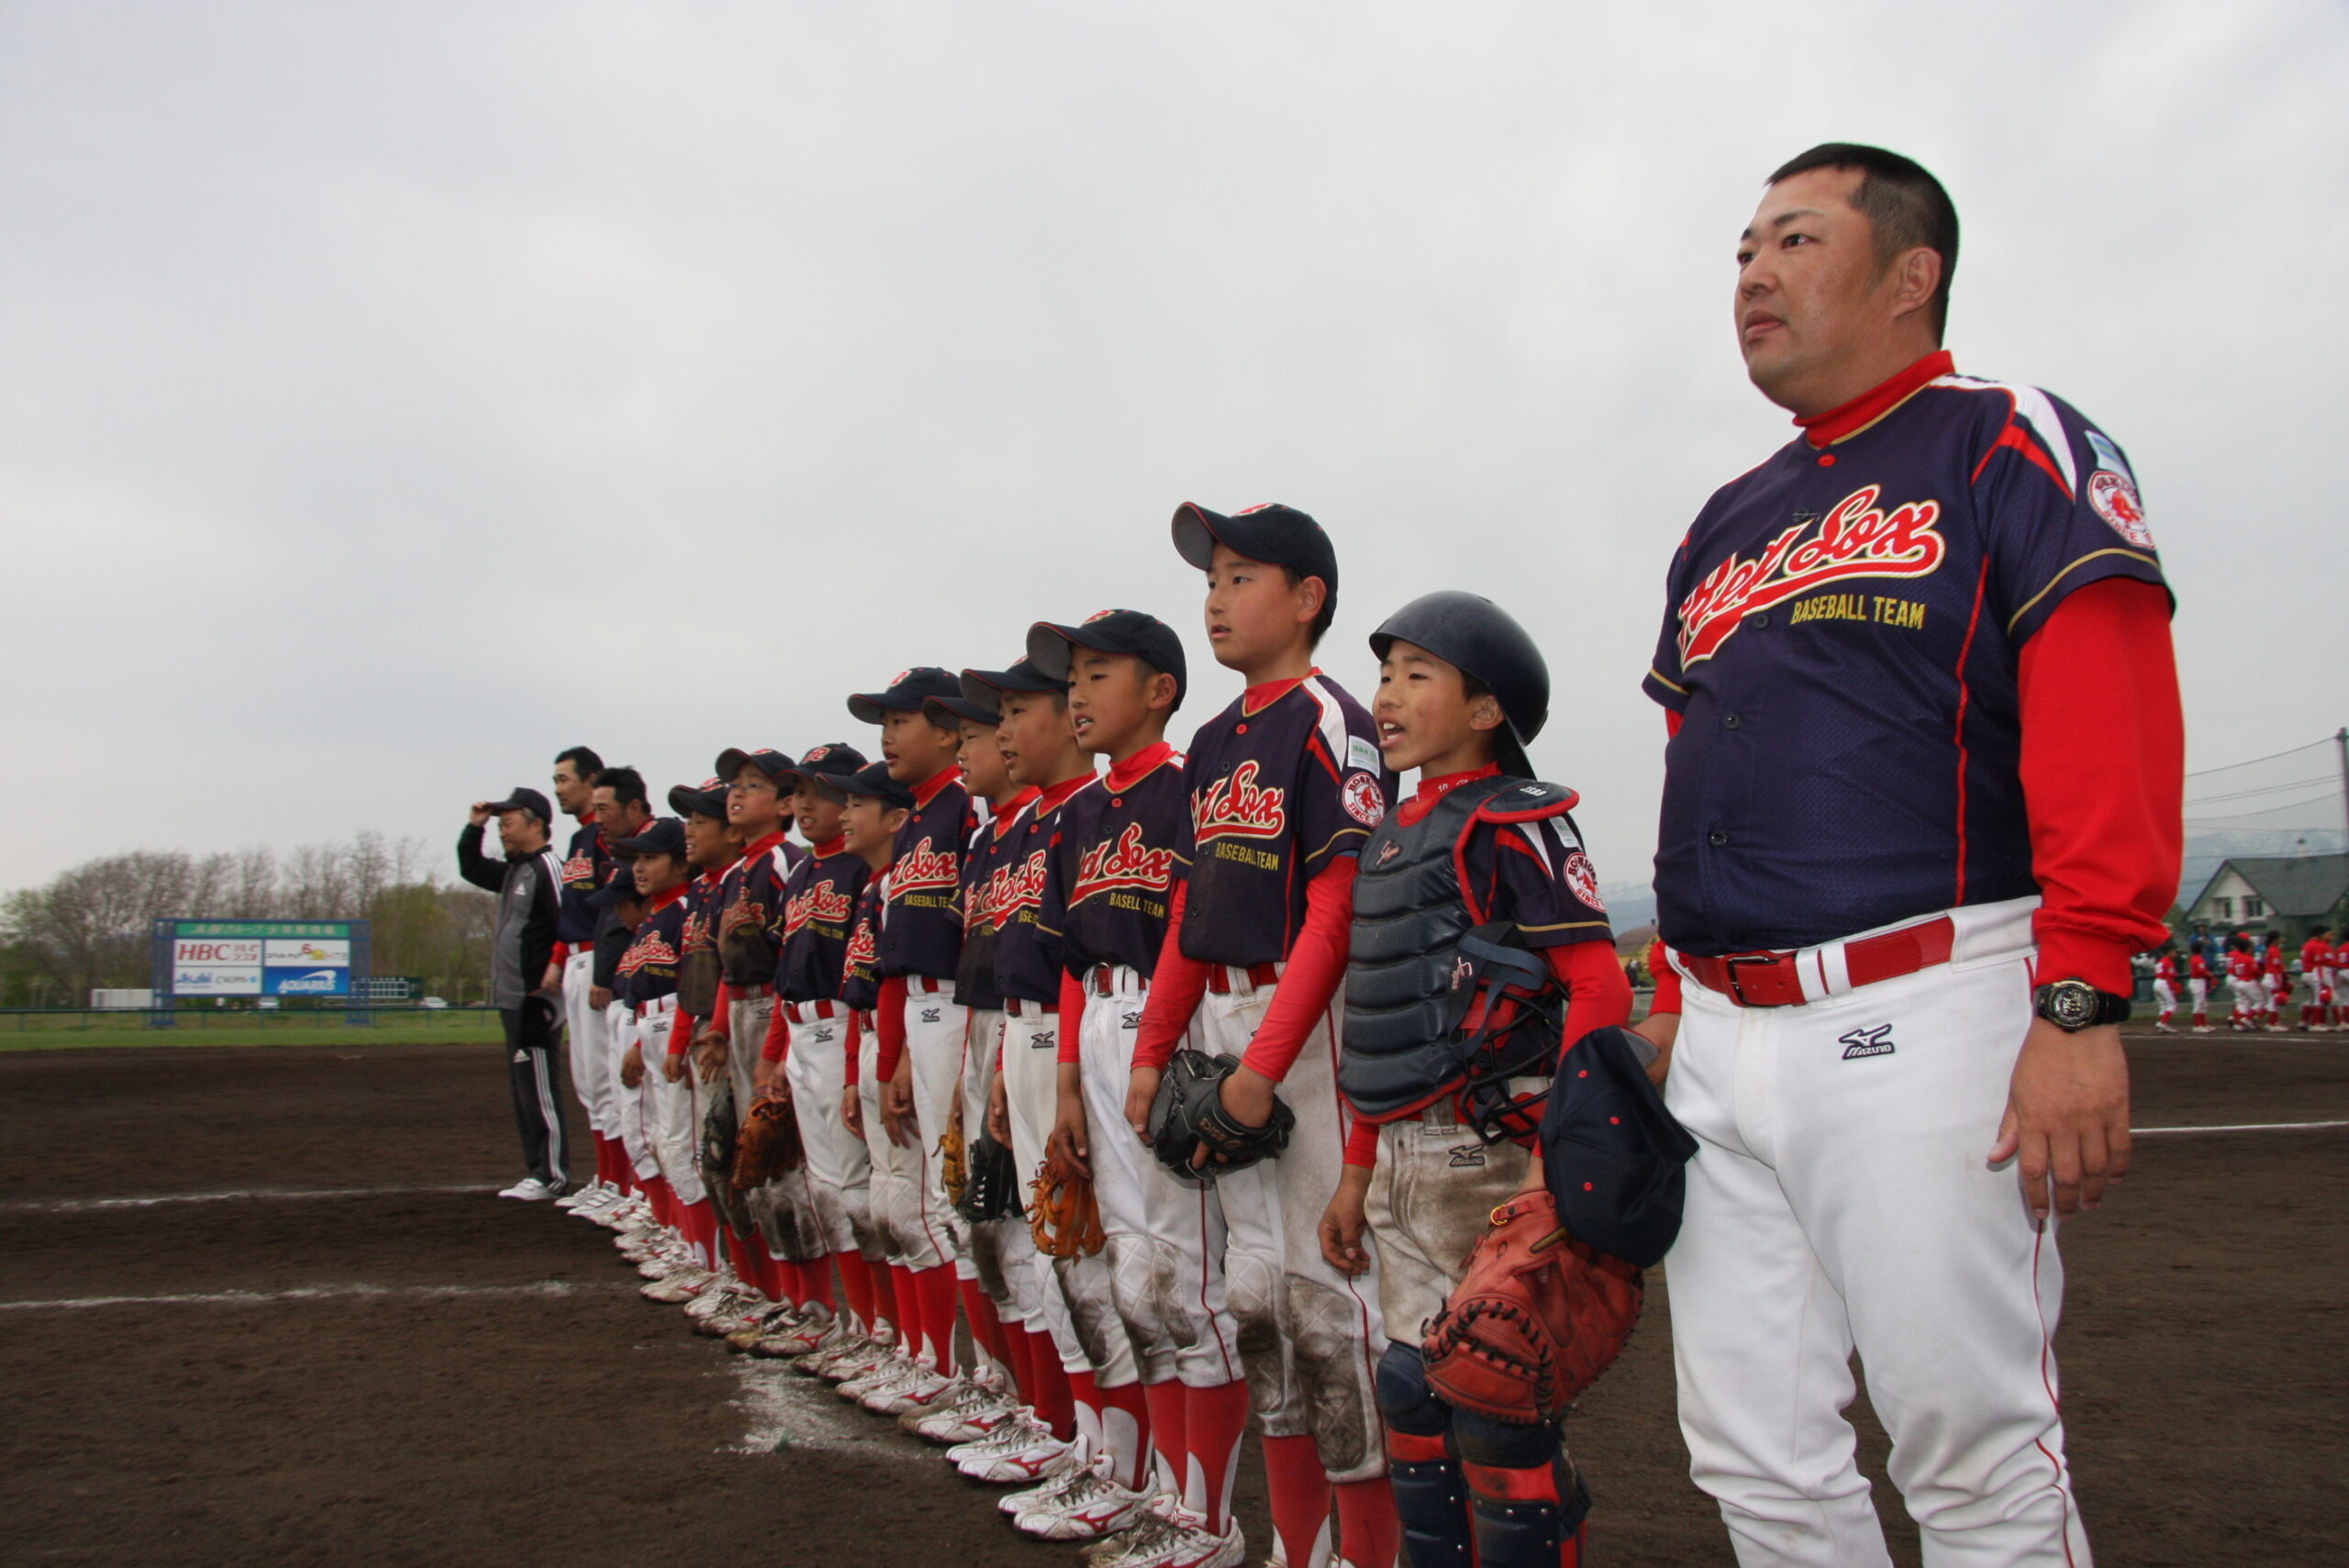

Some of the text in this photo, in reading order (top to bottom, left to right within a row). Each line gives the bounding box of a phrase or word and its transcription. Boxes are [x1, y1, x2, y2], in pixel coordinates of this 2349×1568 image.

[1790, 594, 1926, 629] BASEBALL TEAM
[1348, 803, 1371, 822] SINCE
[1215, 842, 1279, 871] BASEBAL TEAM
[1016, 849, 1047, 897] So
[1109, 892, 1165, 918] BASELL TEAM
[177, 944, 231, 961] HBC
